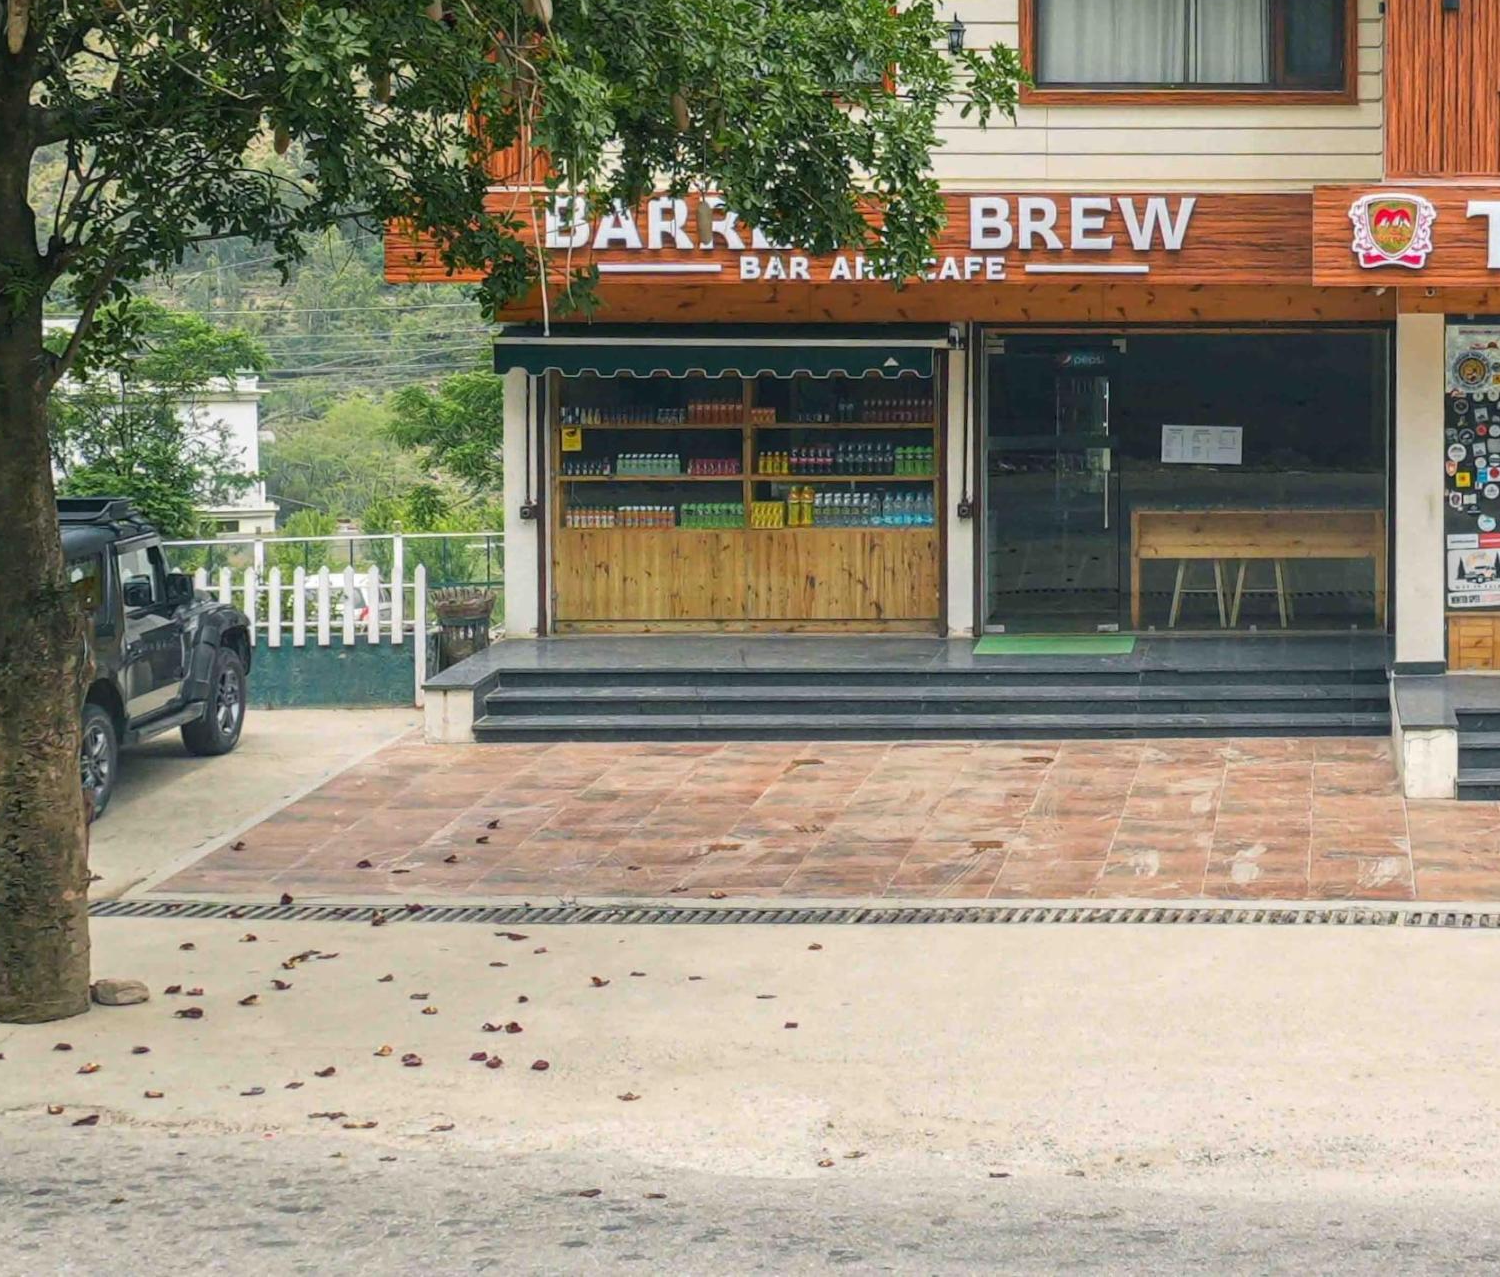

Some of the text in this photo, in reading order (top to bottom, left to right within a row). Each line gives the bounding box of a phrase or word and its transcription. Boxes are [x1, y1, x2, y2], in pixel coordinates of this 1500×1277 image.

[545, 196, 837, 250] BARR
[969, 197, 1197, 251] BREW
[740, 256, 810, 280] BAR
[918, 256, 1007, 281] CAFE
